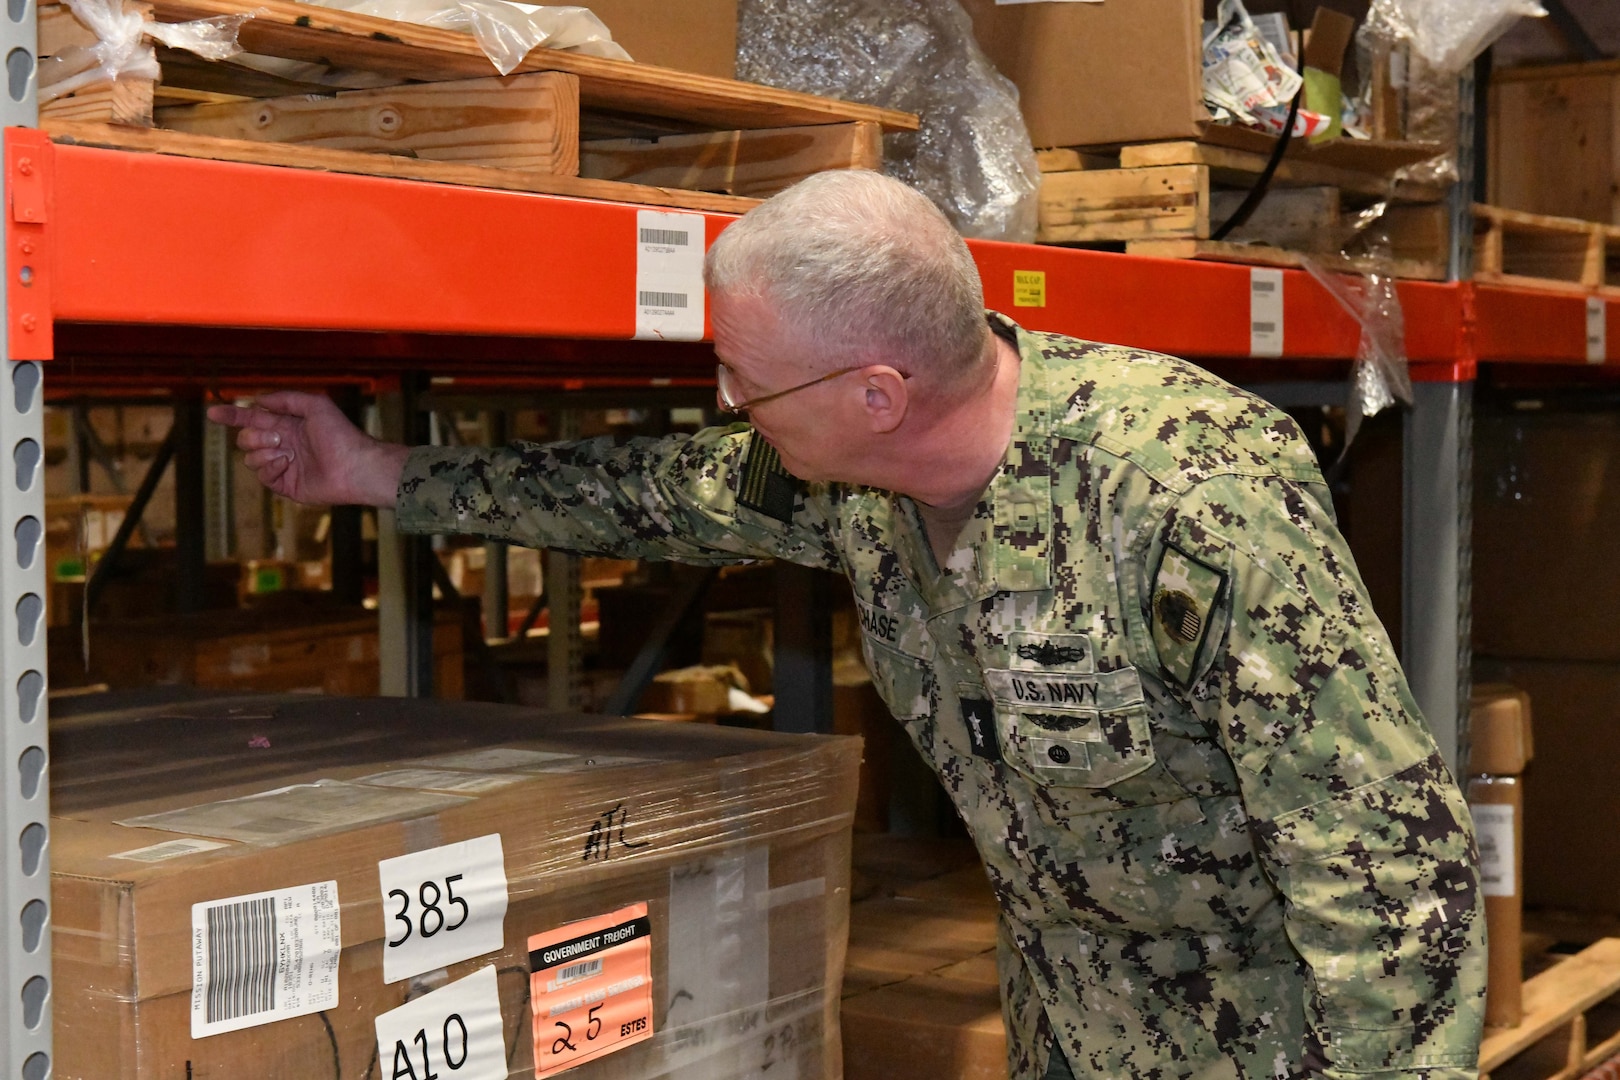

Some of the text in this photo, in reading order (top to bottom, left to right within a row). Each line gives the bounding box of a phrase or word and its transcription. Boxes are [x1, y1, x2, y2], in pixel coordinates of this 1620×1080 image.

[1012, 678, 1100, 705] U.S. NAVY
[388, 874, 469, 948] 385
[194, 927, 203, 1010] MISSION PUTAWAY
[543, 924, 636, 964] GOVERNMENT FREIGHT
[392, 1013, 468, 1080] A10
[620, 1016, 647, 1038] ESTES
